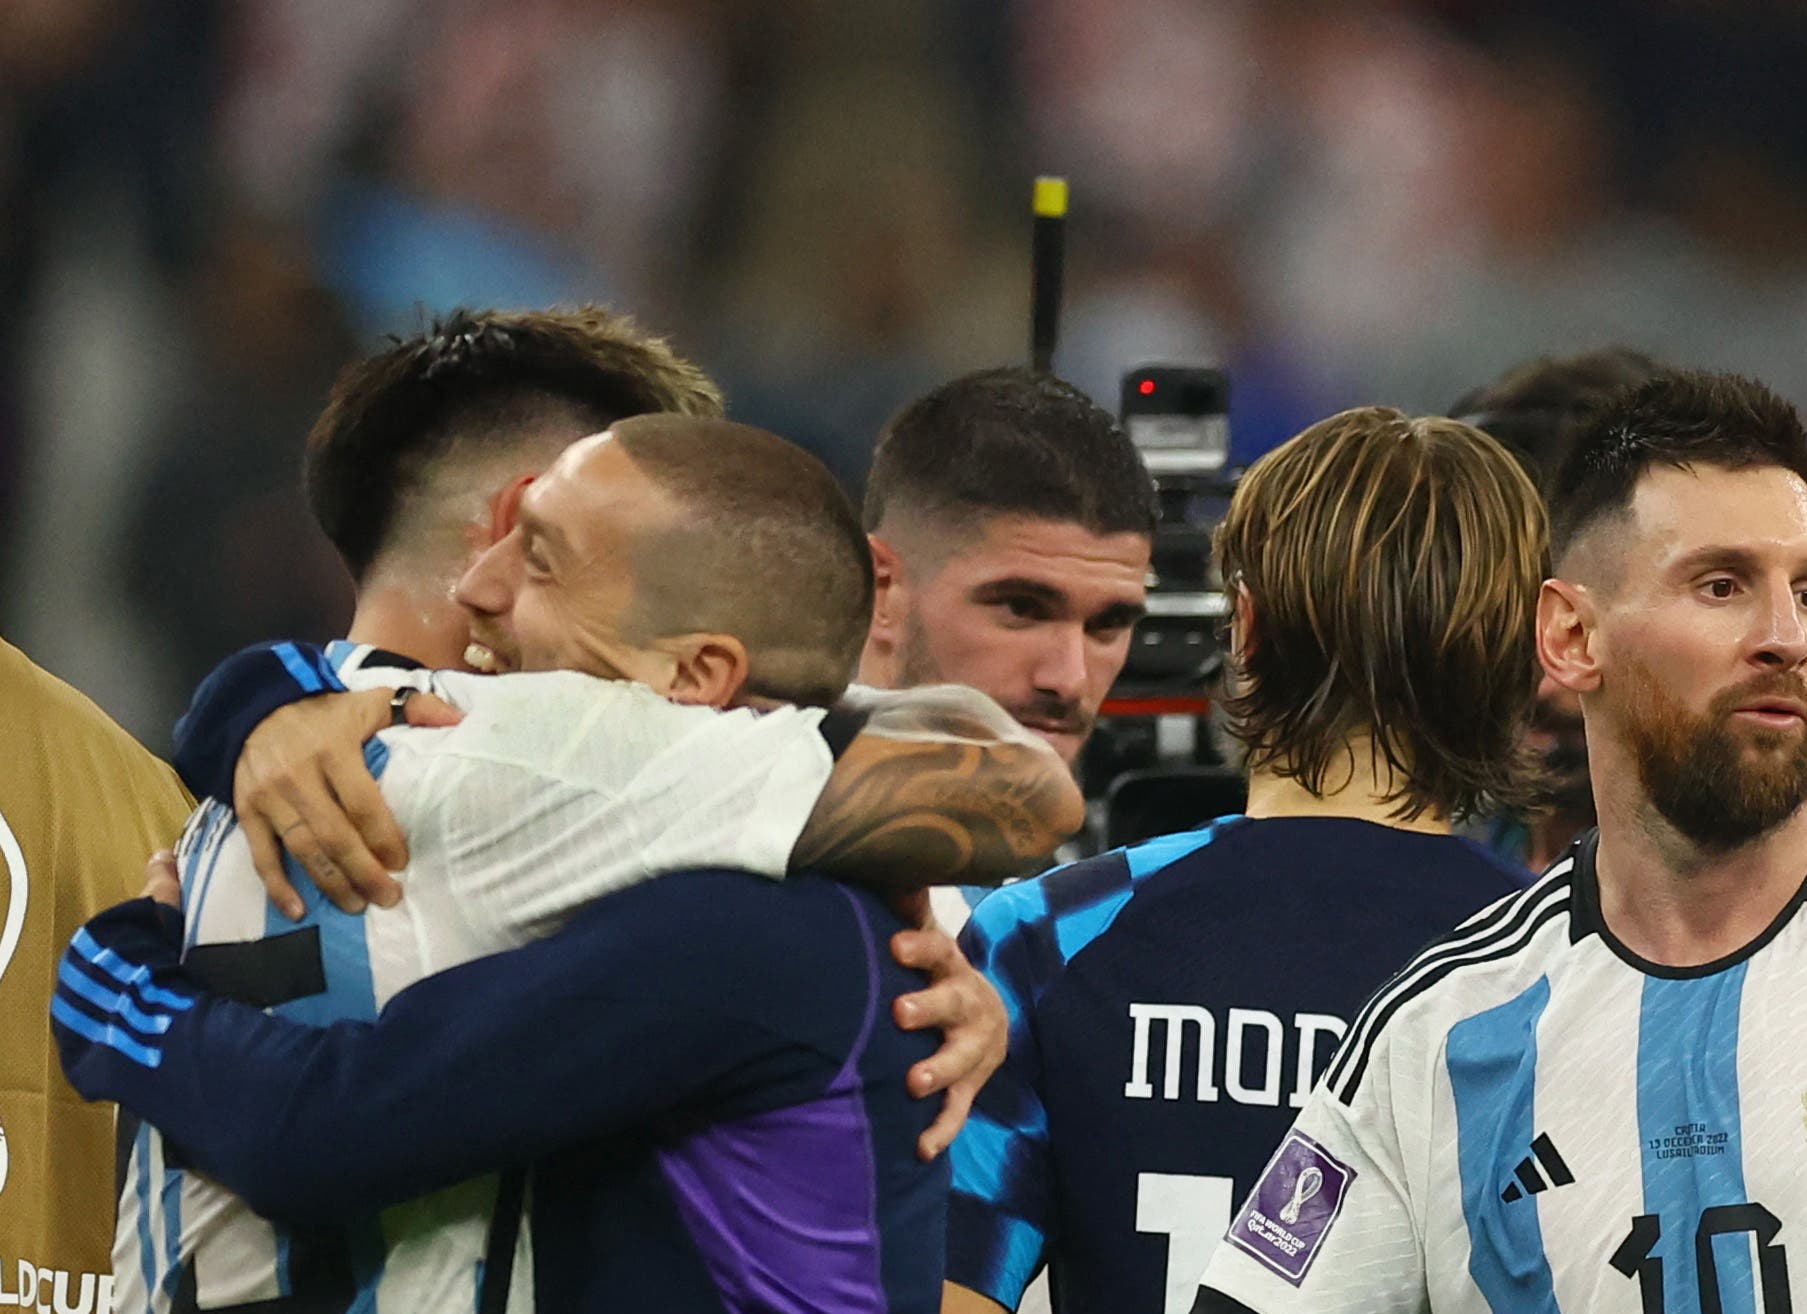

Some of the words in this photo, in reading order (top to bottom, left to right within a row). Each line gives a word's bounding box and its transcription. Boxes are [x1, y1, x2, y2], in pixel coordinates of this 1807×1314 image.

[1250, 1210, 1266, 1224] FIFA
[1264, 1218, 1293, 1241] WORLD
[1290, 1235, 1306, 1249] CUP
